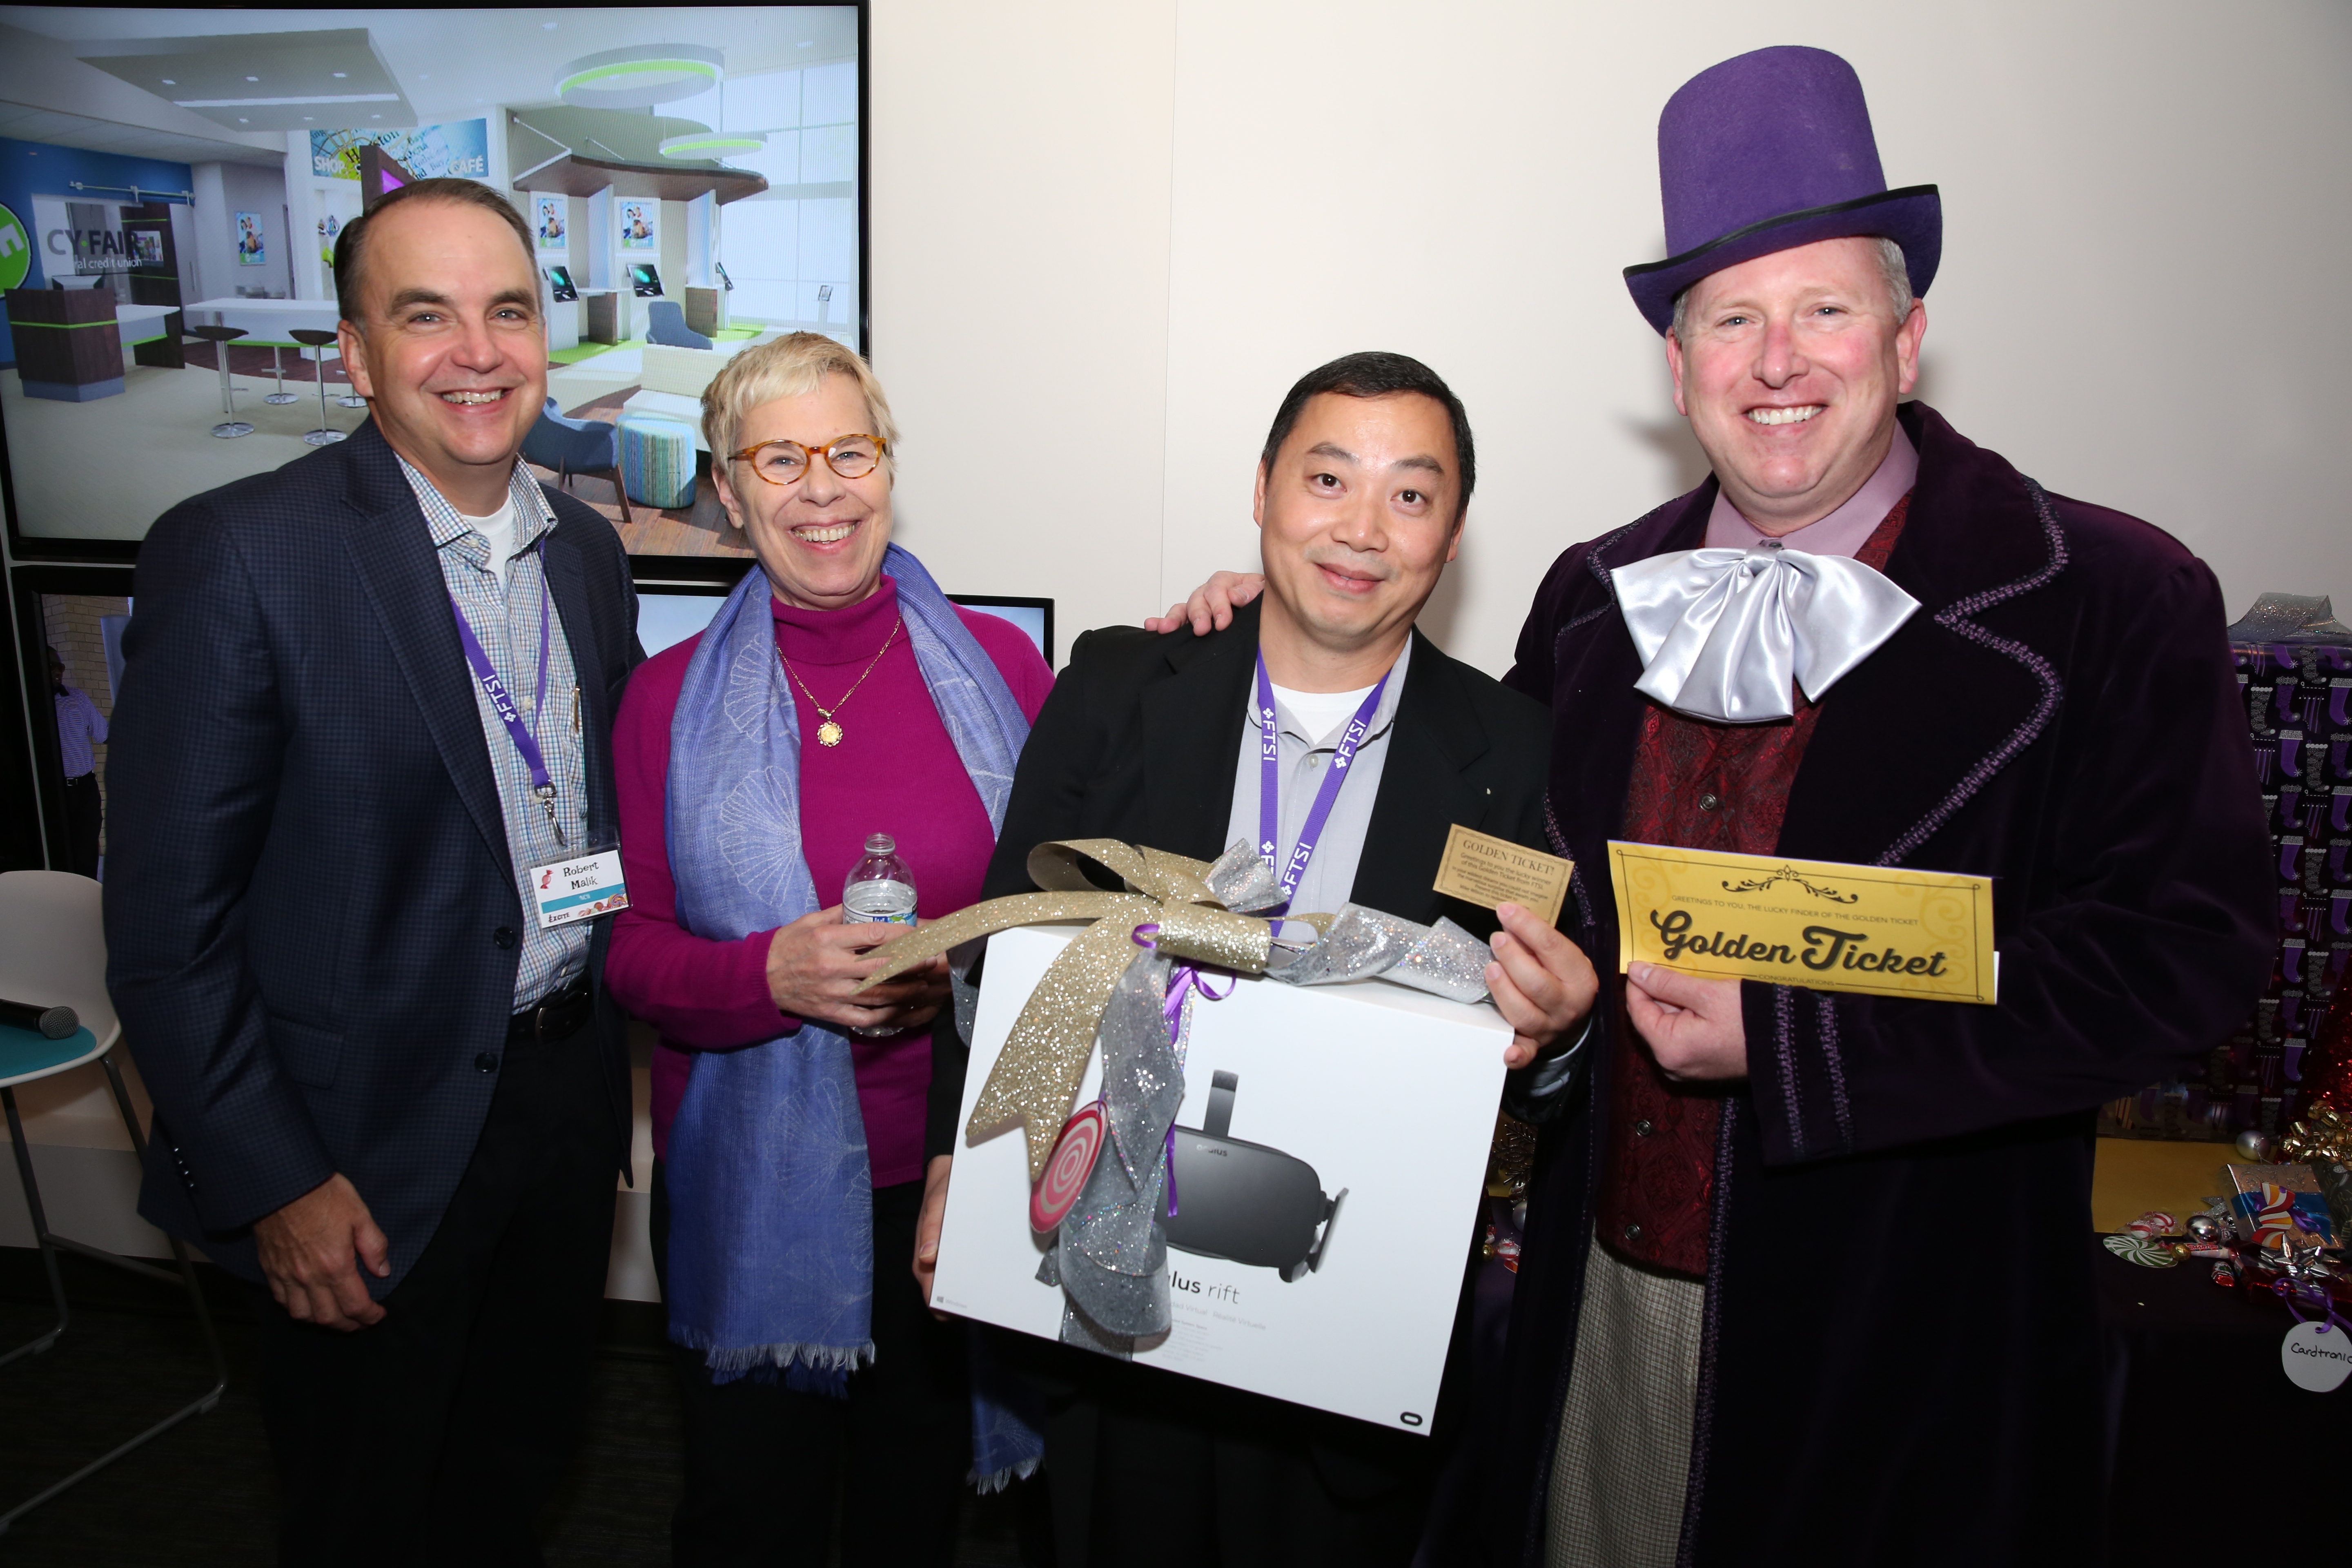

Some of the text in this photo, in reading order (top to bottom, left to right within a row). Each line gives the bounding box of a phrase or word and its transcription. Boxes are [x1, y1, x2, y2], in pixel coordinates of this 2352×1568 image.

[314, 156, 345, 173] SHOP
[450, 156, 484, 174] CAFÉ
[88, 258, 115, 269] credit
[117, 257, 142, 268] union
[482, 674, 512, 713] FTSI
[1263, 720, 1276, 761] FTSI
[1339, 719, 1366, 757] FTSI
[563, 862, 599, 877] Robert
[1284, 842, 1312, 886] FTSI
[1460, 852, 1486, 865] Greetings
[1515, 871, 1530, 879] lucky
[1463, 840, 1553, 874] GOLDEN TICKET!
[571, 876, 598, 890] Malik
[1478, 865, 1498, 875] Golden
[1499, 871, 1515, 880] Ticket
[1672, 895, 1712, 905] GREETINGS
[1727, 902, 1745, 910] YOU,
[1764, 906, 1788, 914] LUCKY
[1788, 908, 1819, 917] FINDER
[1852, 914, 1888, 923] GOLDEN
[1889, 916, 1918, 926] TICKET
[1650, 910, 1947, 977] Golden Ticket
[1759, 974, 1834, 985] CONGRATULATIONS
[1168, 1270, 1240, 1304] lus rift
